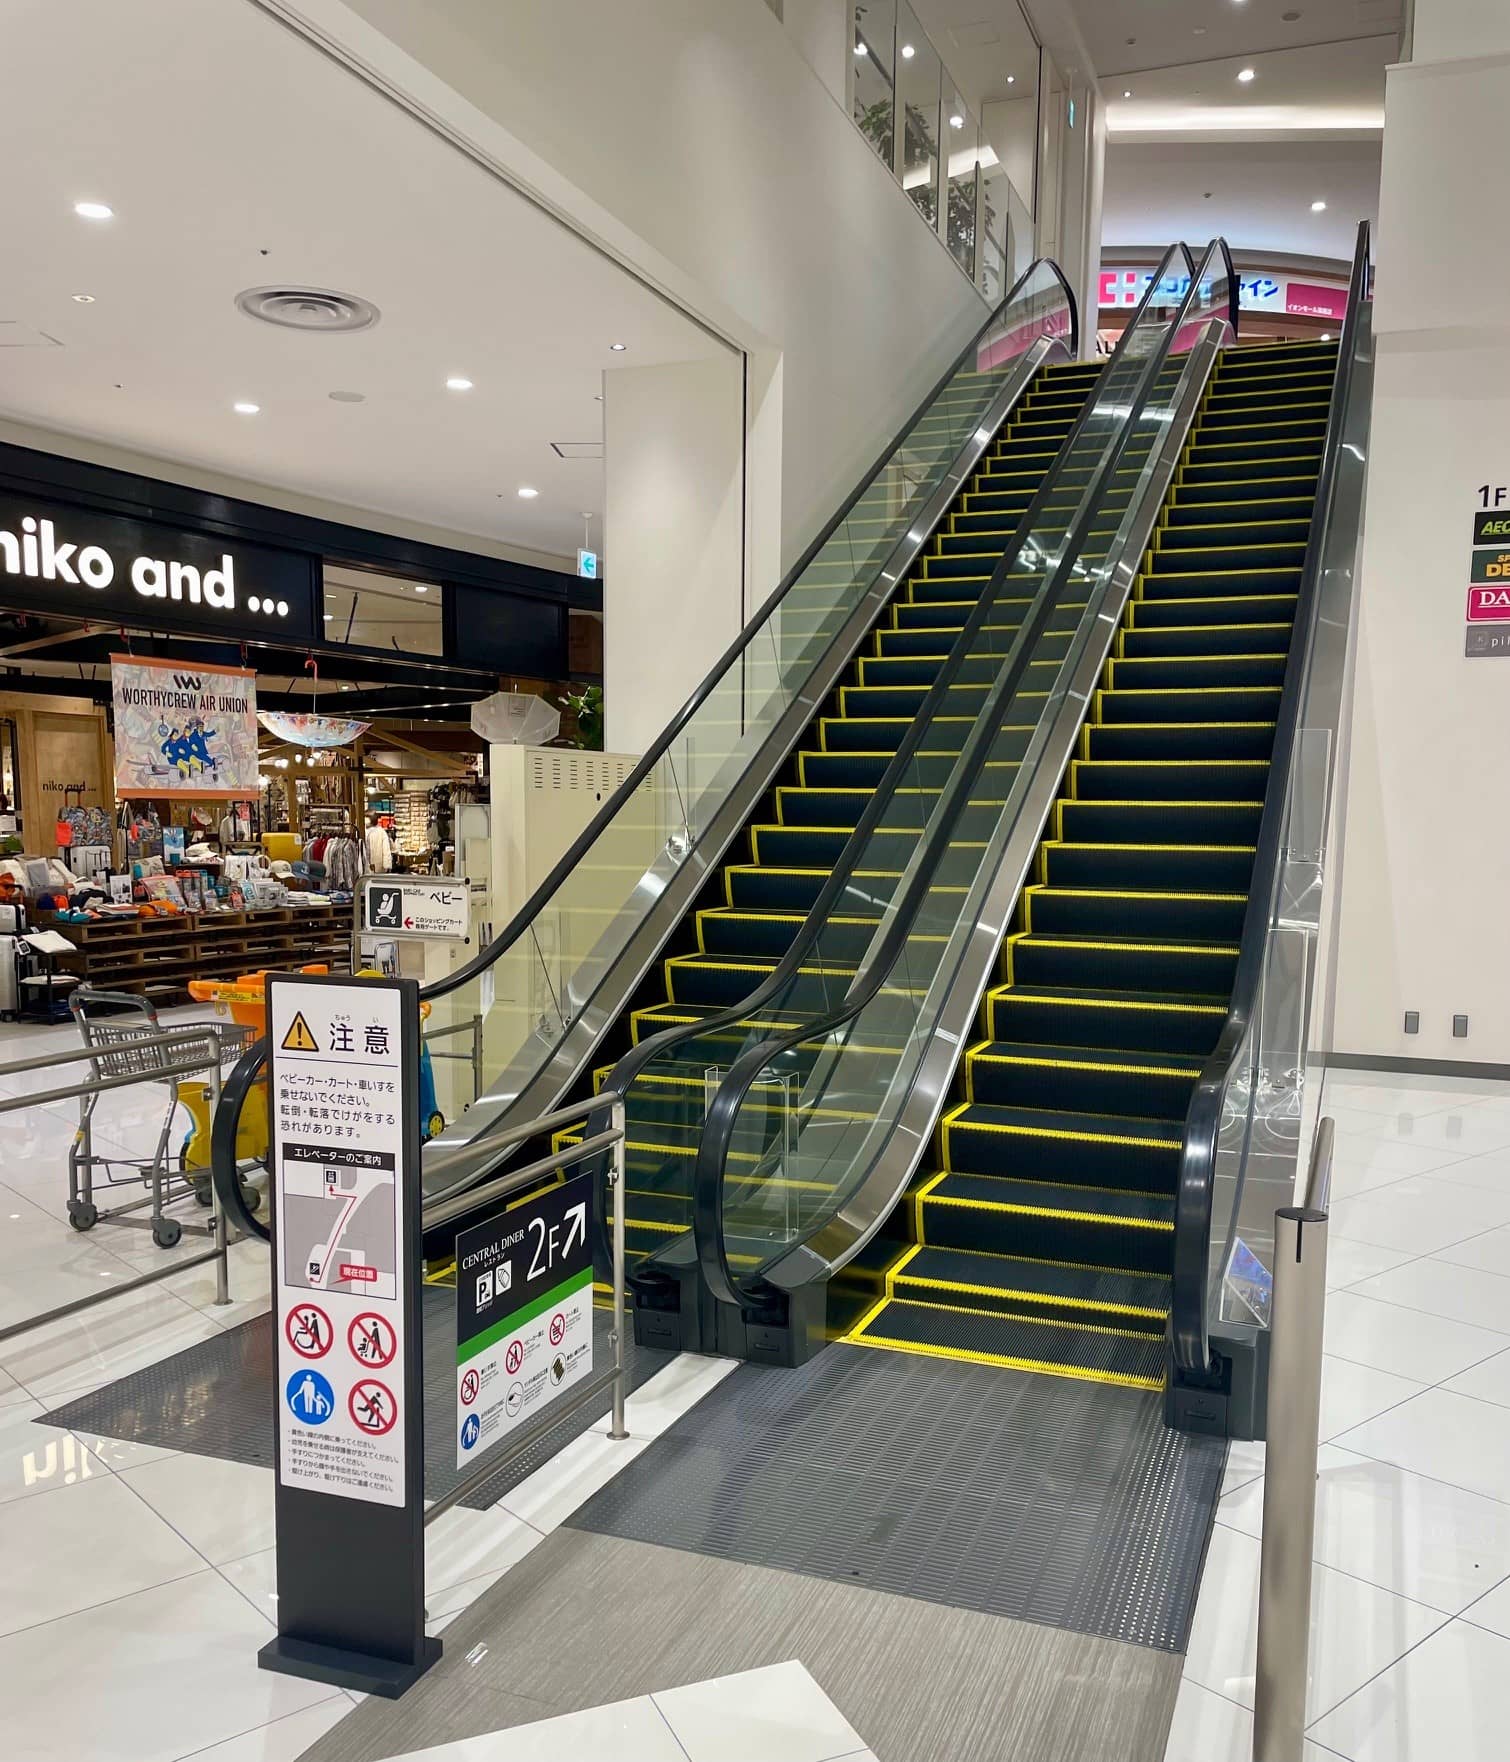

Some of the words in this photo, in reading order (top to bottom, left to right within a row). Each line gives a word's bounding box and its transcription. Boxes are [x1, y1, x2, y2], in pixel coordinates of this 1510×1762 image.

[1478, 485, 1507, 508] 1F
[131, 554, 236, 609] and
[122, 687, 197, 710] WORTHYCREW
[199, 697, 217, 712] AIR
[219, 698, 248, 713] UNION
[42, 780, 64, 792] niko
[429, 891, 463, 906] ベビー
[279, 1073, 395, 1093] ベビーカー・カート・車いすを
[280, 1088, 371, 1107] 乗せないでください。
[280, 1104, 396, 1125] 転倒・転落でけがをする
[280, 1120, 361, 1139] 恐れがあります。
[294, 1148, 382, 1166] エレベーターのご案内
[462, 1245, 500, 1270] CENTRAL
[500, 1229, 526, 1250] DINER
[526, 1216, 560, 1282] 2F
